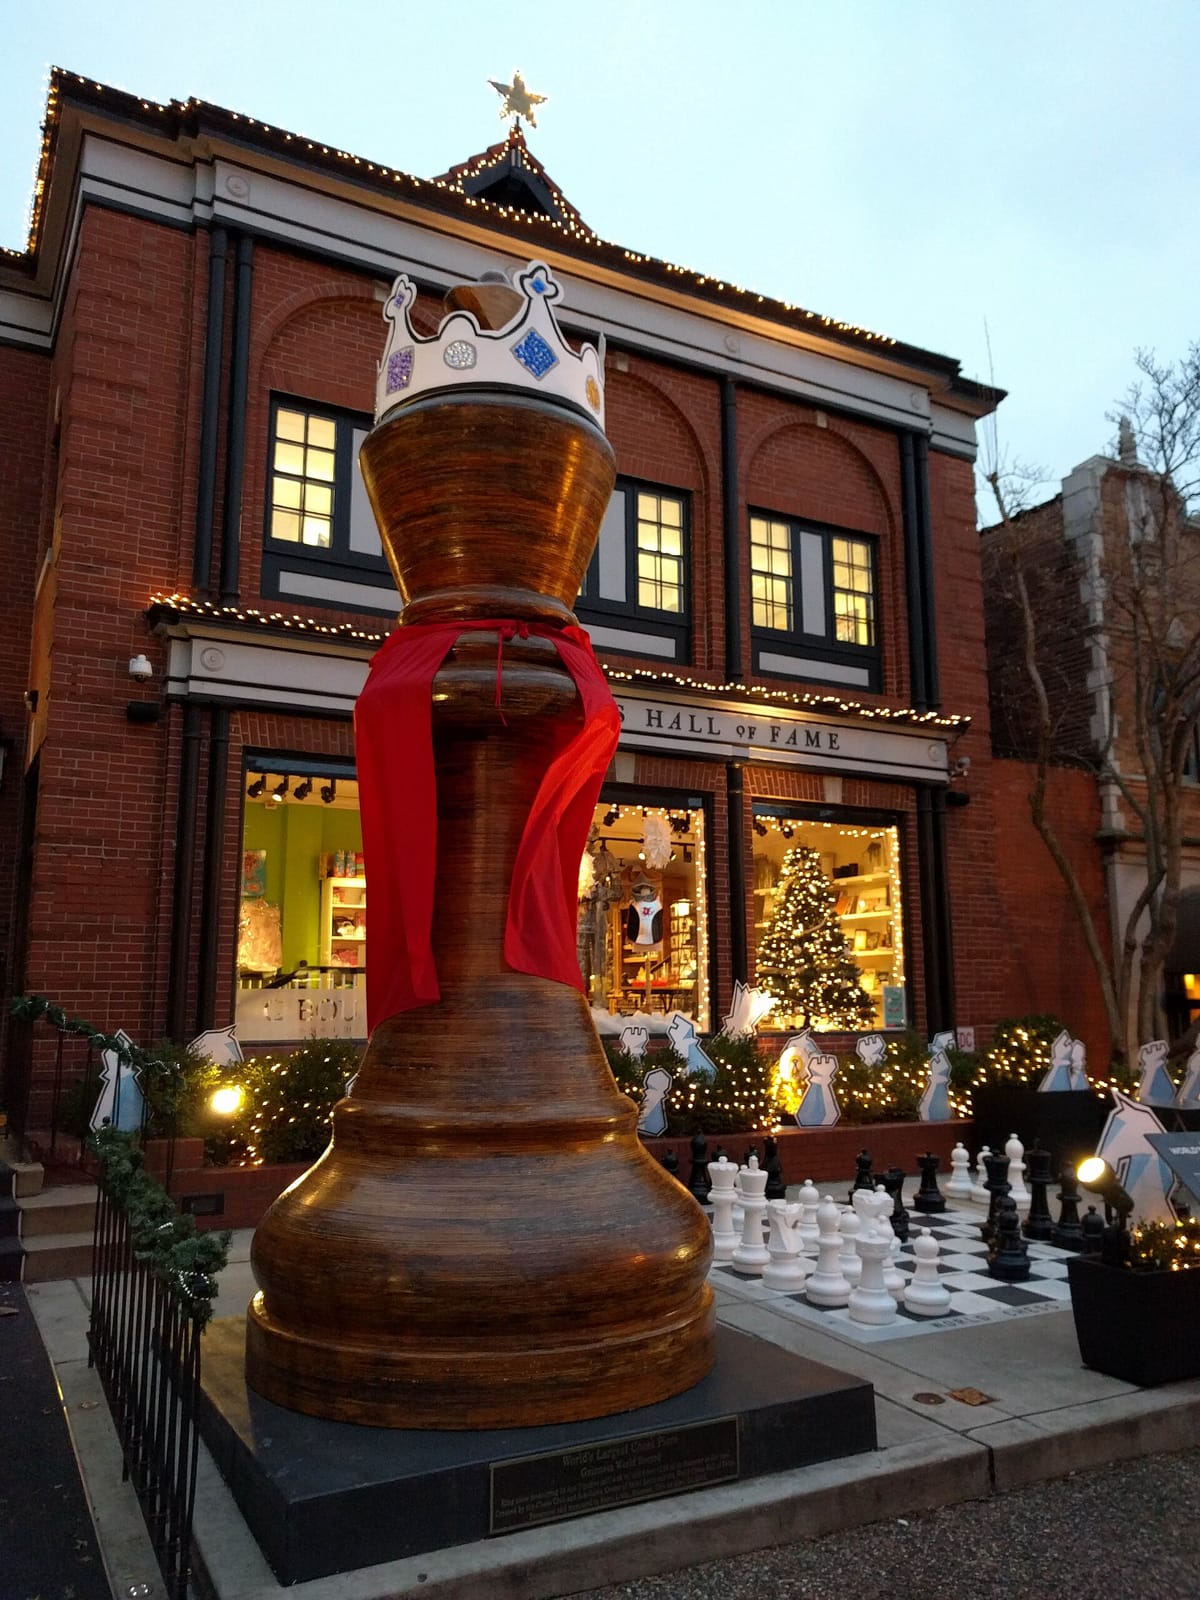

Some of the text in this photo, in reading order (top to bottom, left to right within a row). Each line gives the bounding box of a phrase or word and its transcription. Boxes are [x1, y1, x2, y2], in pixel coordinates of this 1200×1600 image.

[646, 708, 721, 736] HALL
[736, 724, 757, 740] OF
[770, 725, 841, 751] FAME
[931, 1314, 990, 1328] WORLD
[563, 1451, 594, 1466] World's
